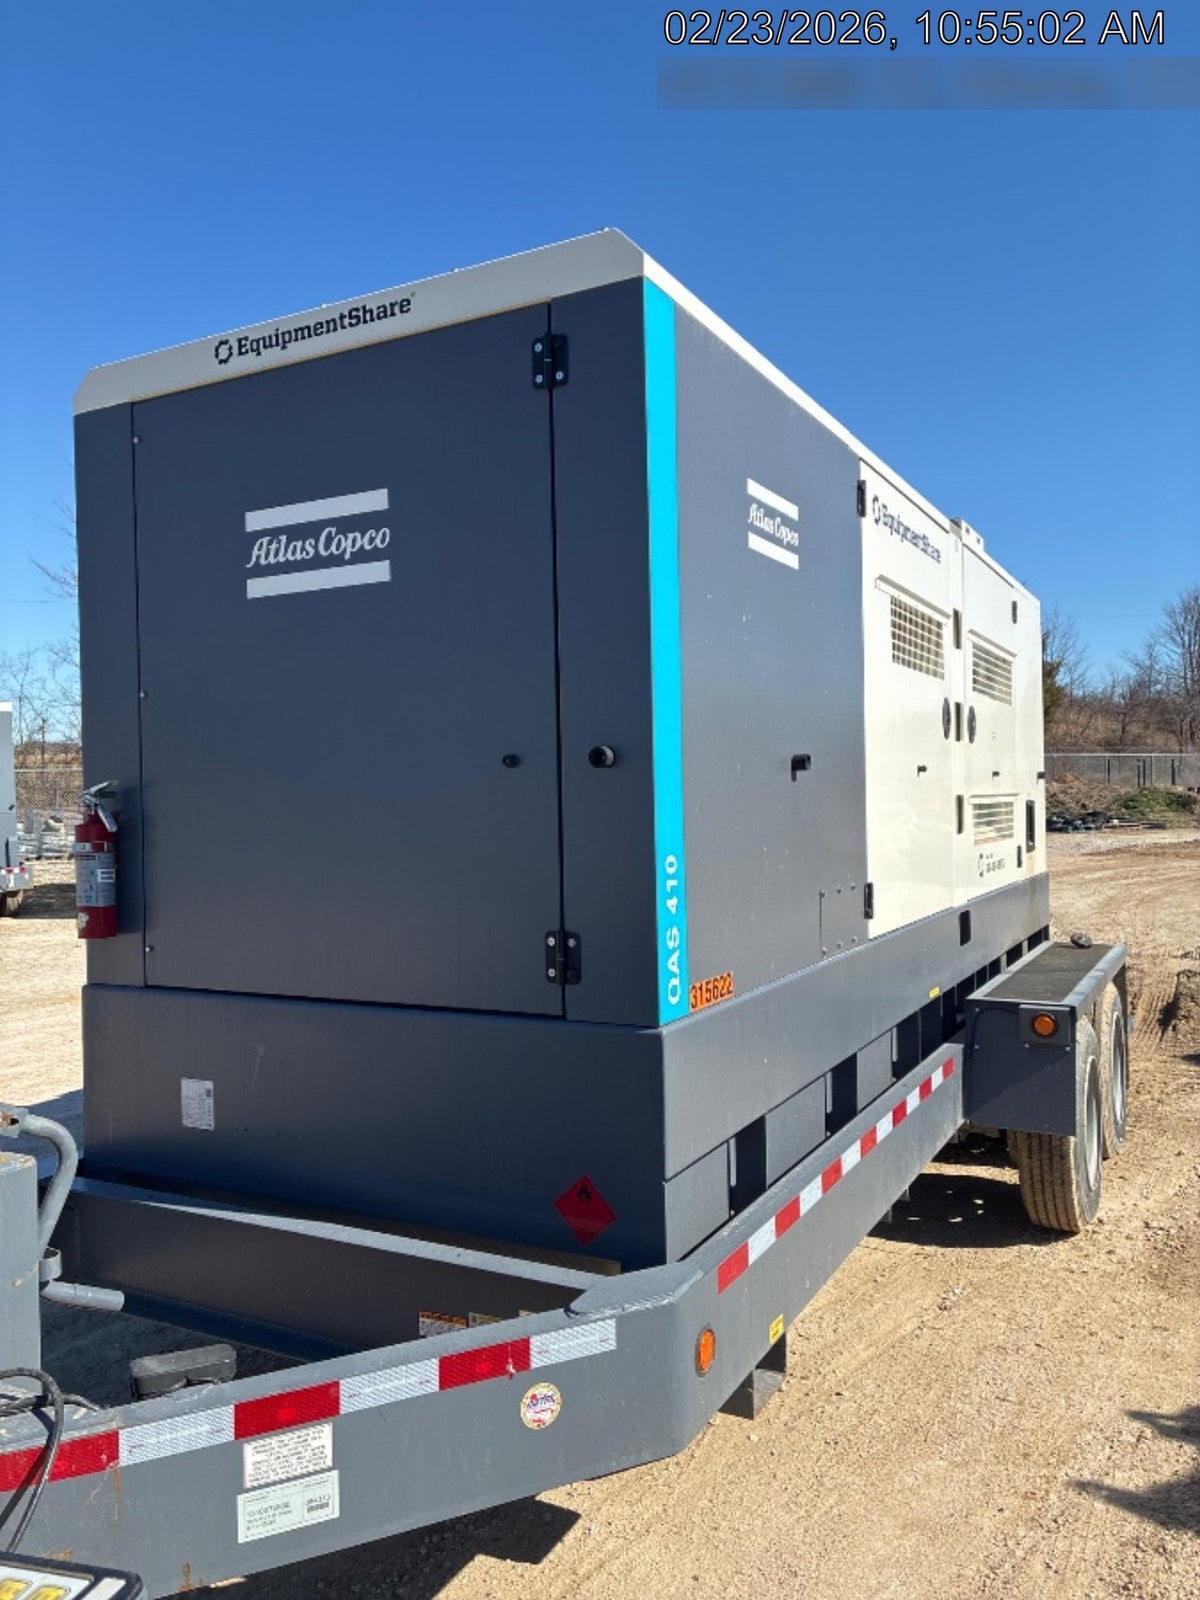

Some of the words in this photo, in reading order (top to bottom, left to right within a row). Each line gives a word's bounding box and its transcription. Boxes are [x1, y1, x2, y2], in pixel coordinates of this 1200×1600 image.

[237, 297, 411, 357] EquipmentShare
[881, 502, 942, 564] EquipmentShare
[664, 854, 679, 915] 410
[665, 925, 681, 1006] QAS
[691, 971, 733, 1010] 315622
